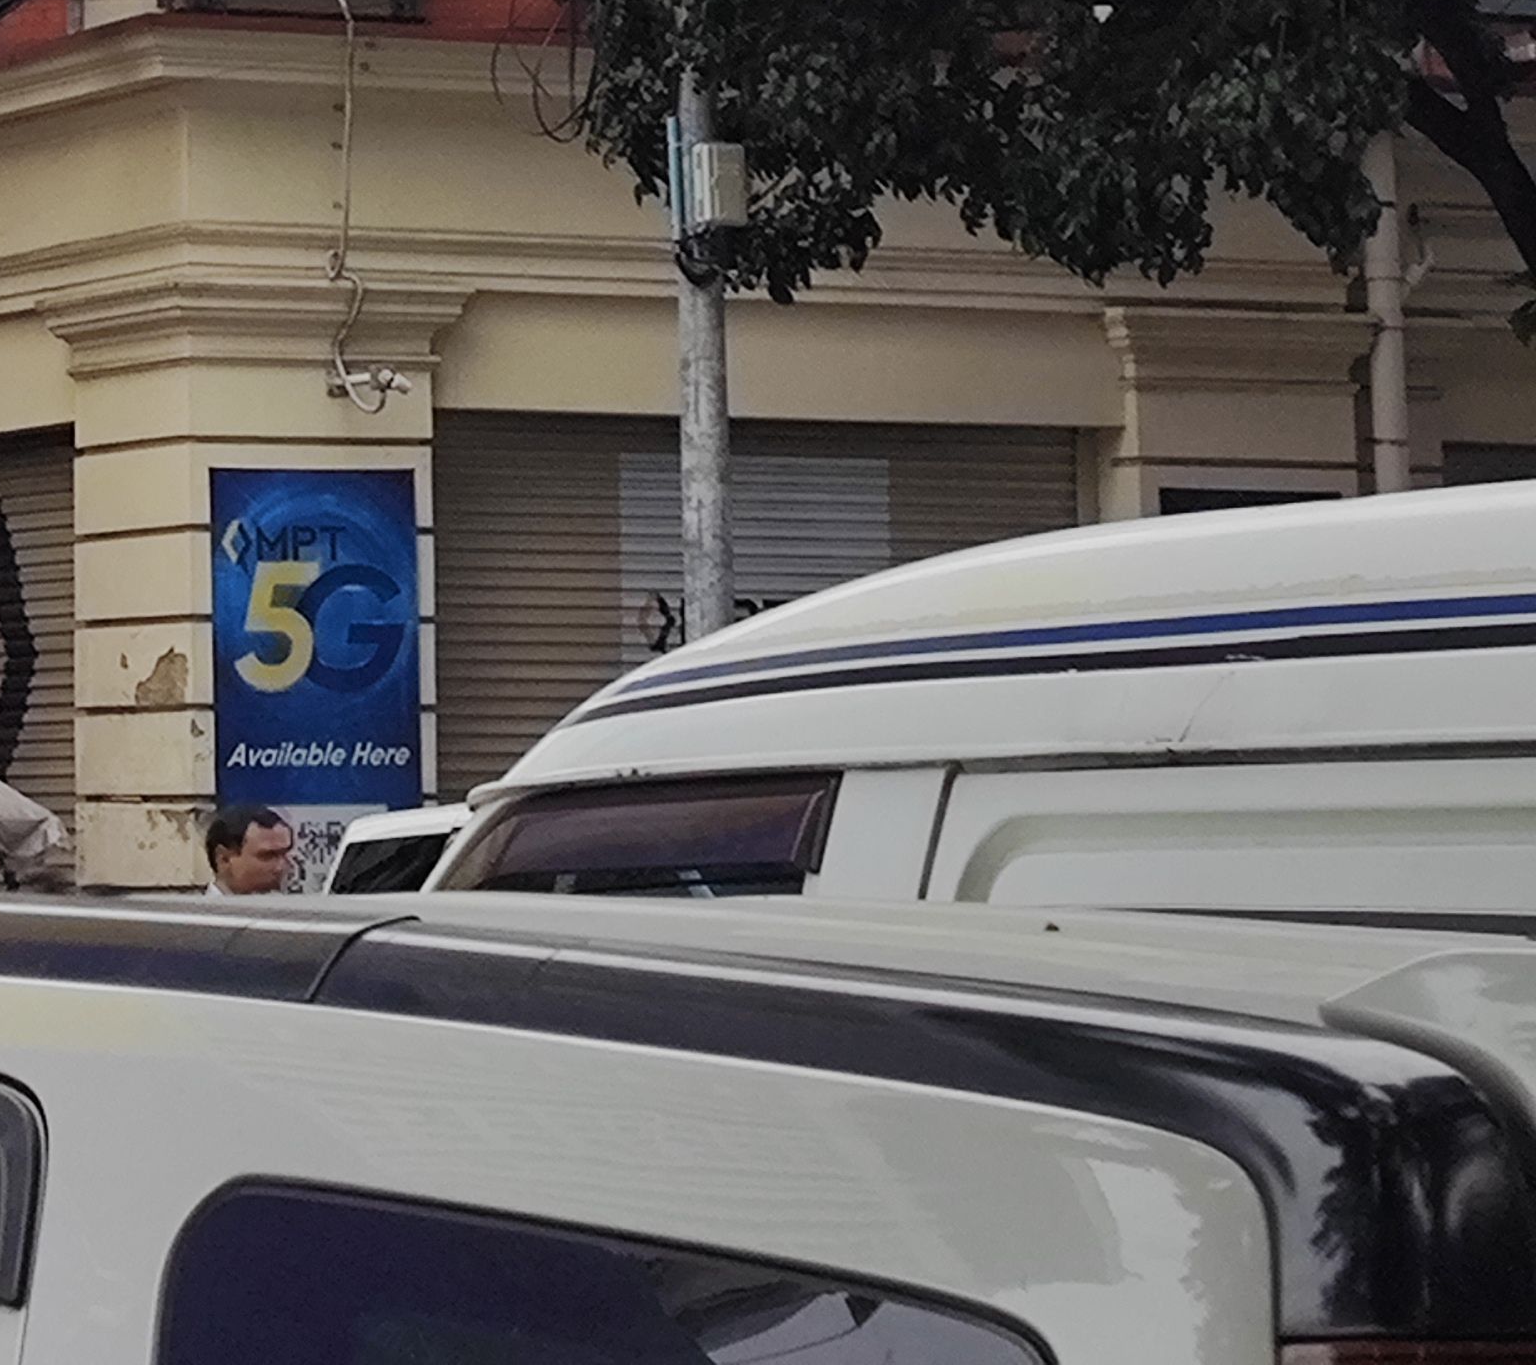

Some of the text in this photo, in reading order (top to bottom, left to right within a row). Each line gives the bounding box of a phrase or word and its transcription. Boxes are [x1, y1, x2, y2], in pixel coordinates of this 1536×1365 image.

[255, 525, 347, 561] MPT
[234, 561, 407, 694] 5G
[226, 740, 412, 768] Available Here
